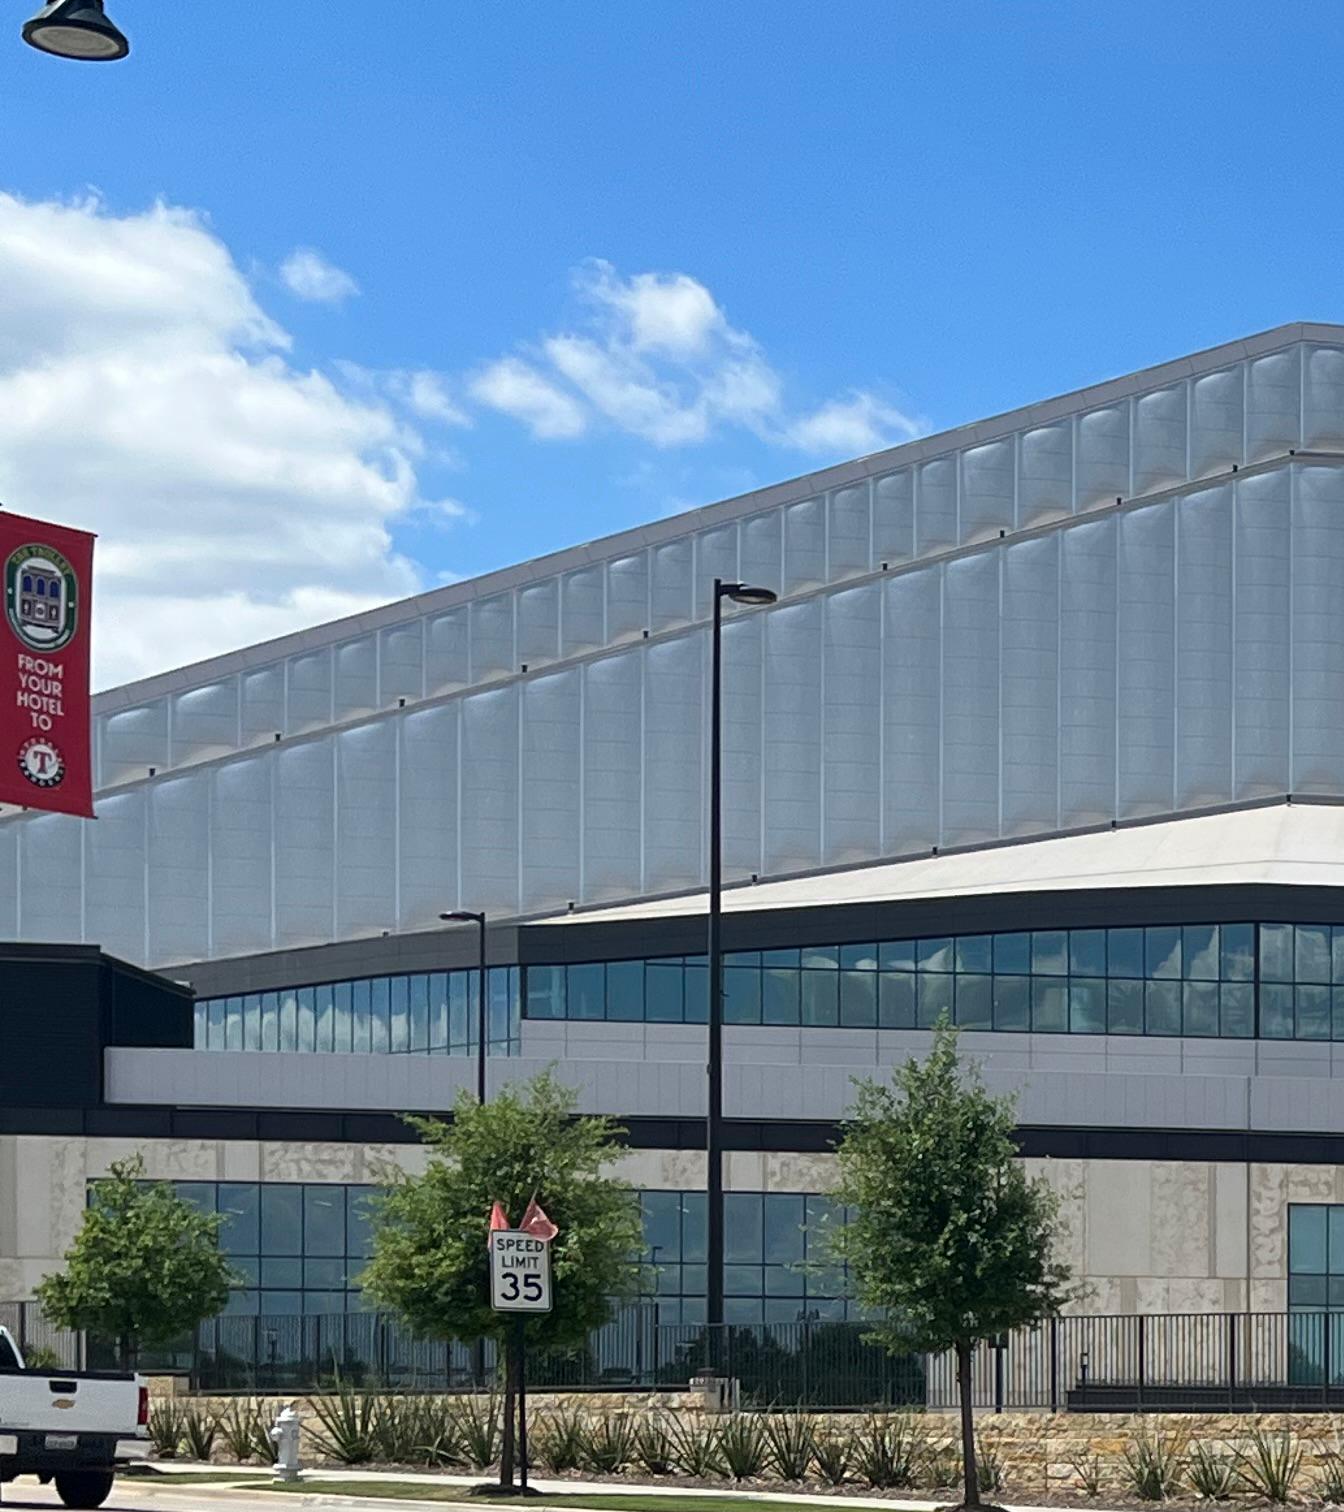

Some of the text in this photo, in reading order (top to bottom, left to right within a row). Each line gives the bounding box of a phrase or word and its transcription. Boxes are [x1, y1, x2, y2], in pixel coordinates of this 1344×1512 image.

[18, 653, 63, 679] FROM
[19, 672, 62, 698] YOUR
[16, 691, 64, 716] HOTEL
[30, 711, 52, 731] TO
[497, 1239, 544, 1252] SPEED
[502, 1256, 539, 1268] LIMIT
[501, 1272, 542, 1301] 35
